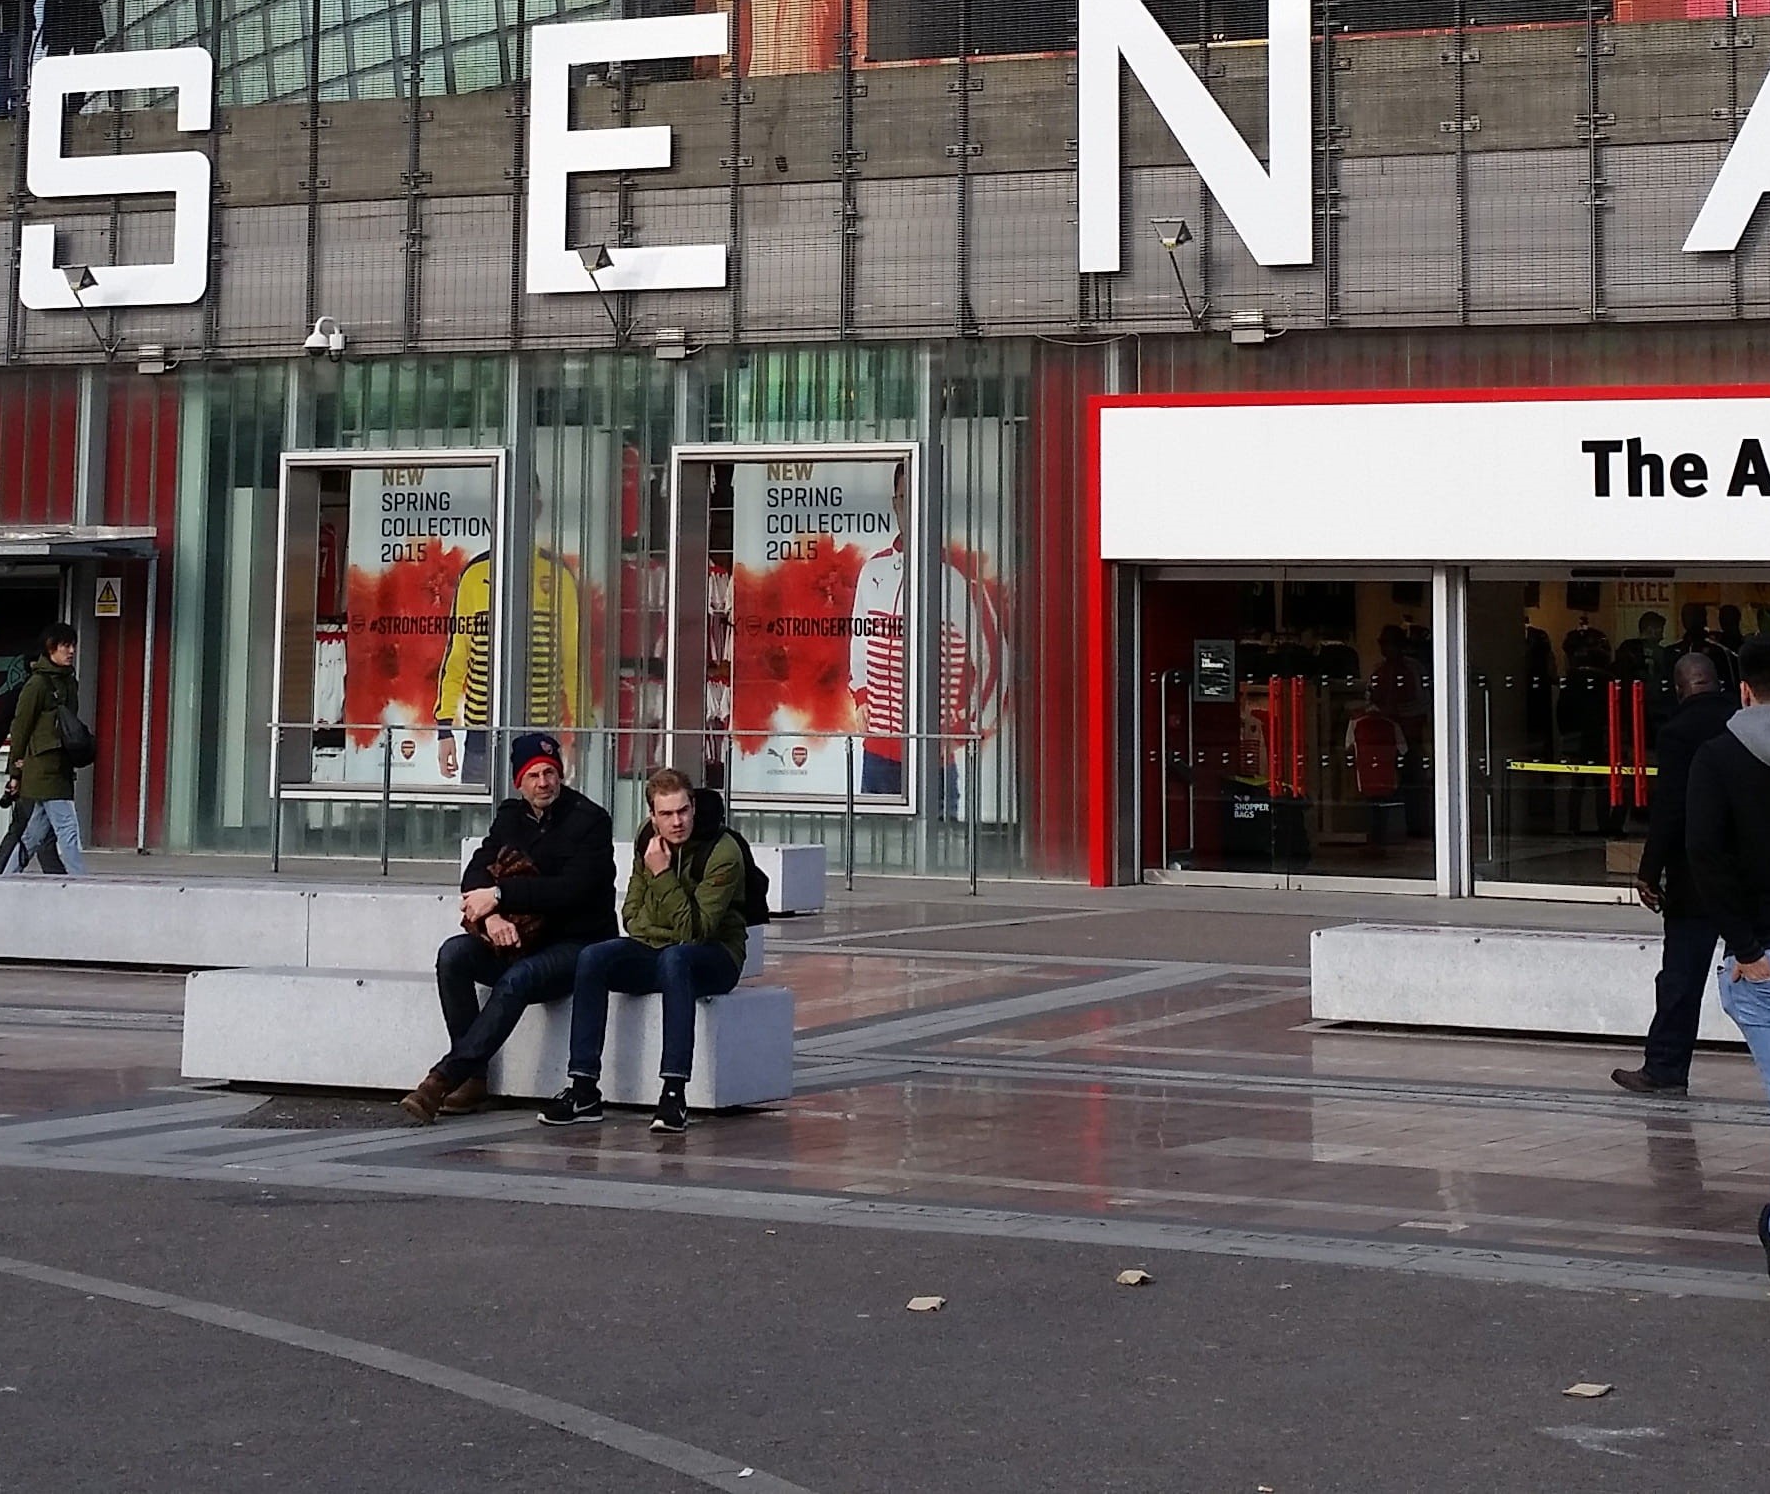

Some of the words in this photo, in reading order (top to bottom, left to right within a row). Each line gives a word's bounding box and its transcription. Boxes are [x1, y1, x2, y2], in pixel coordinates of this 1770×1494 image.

[382, 468, 425, 486] NEW
[767, 462, 814, 481] NEW
[1581, 436, 1709, 498] The
[381, 491, 451, 512] SPRING
[766, 487, 843, 508] SPRING
[381, 517, 491, 537] COLLECTION
[766, 513, 891, 534] COLLECTION
[381, 543, 427, 563] 2015
[766, 540, 819, 561] 2015
[1234, 803, 1270, 811] SHOPPER
[1234, 811, 1255, 819] BAGS
